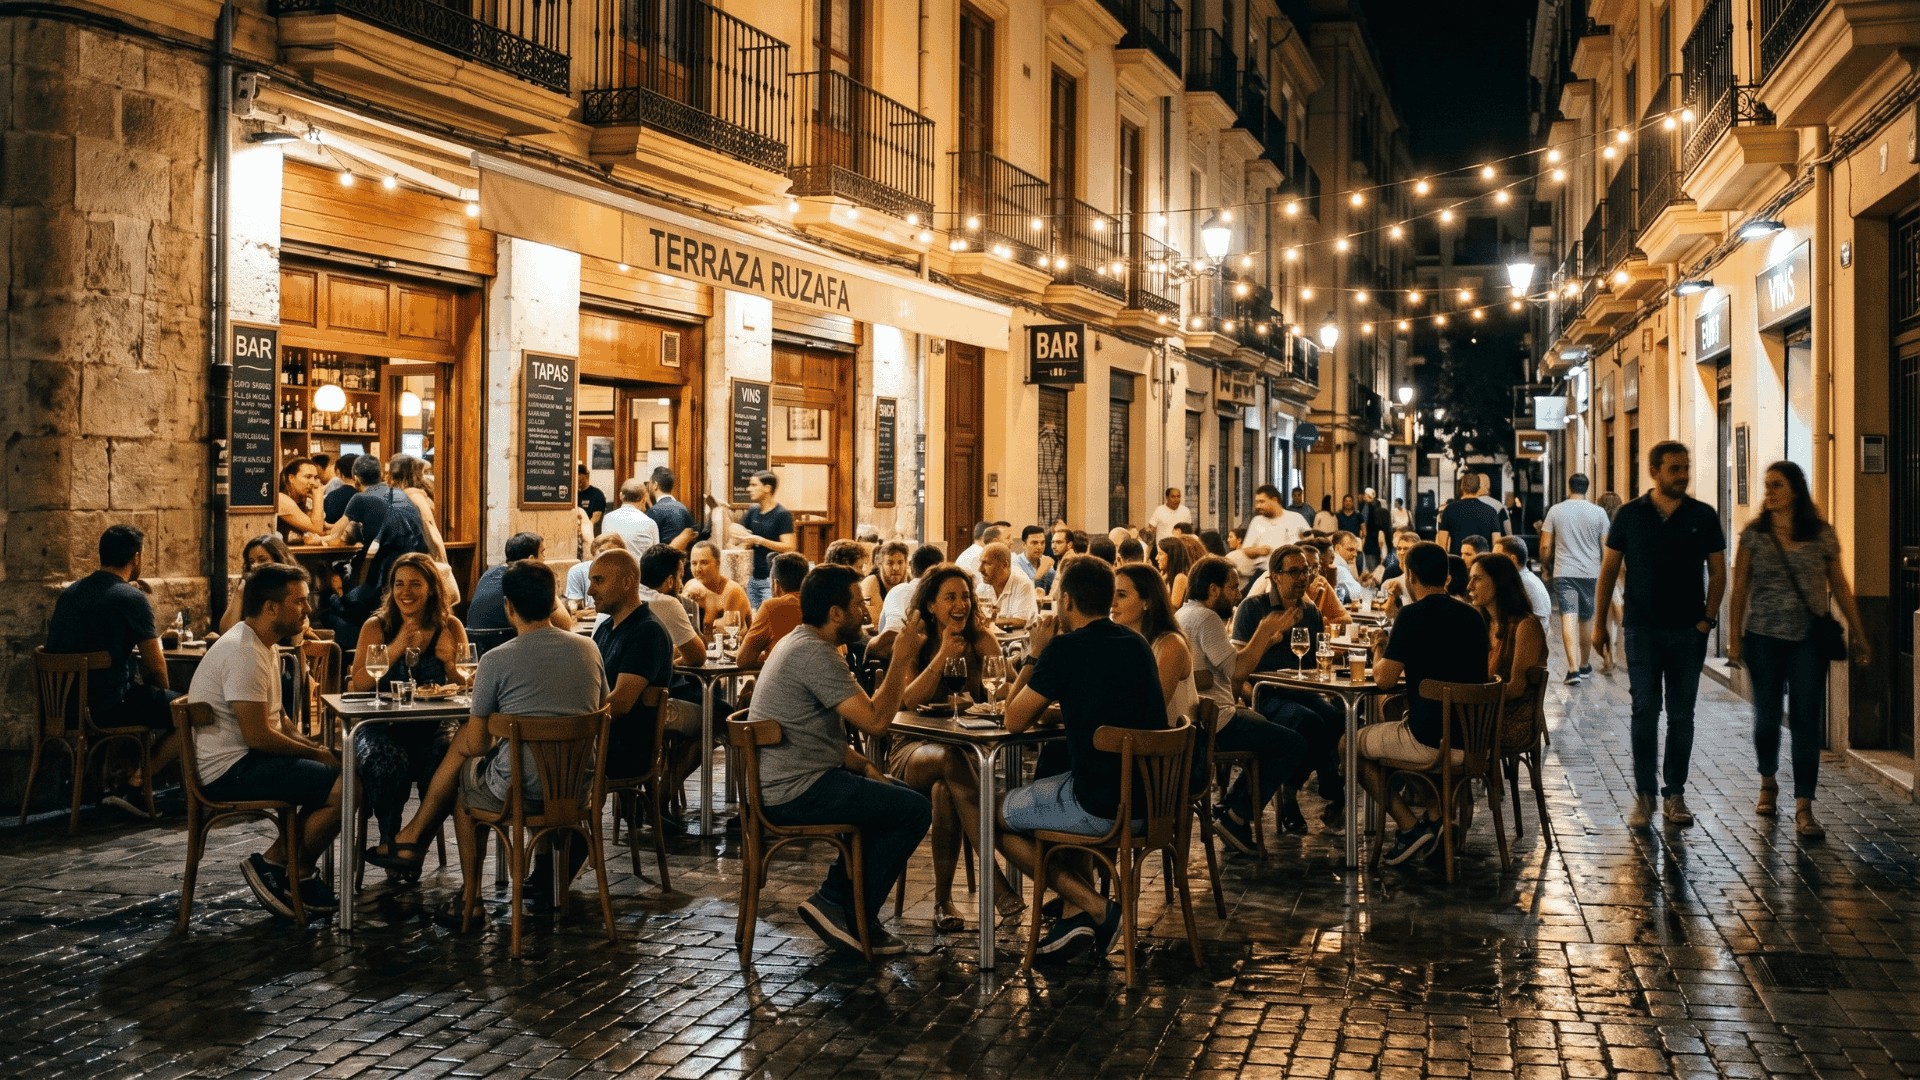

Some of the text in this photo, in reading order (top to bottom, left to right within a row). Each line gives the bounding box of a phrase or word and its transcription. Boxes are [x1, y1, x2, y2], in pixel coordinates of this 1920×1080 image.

[649, 227, 851, 312] TERRAZA RUZAFA
[1768, 264, 1795, 312] VINS
[235, 334, 272, 360] BAR
[1036, 331, 1078, 359] BAR
[532, 361, 569, 383] TAPAS
[741, 386, 761, 404] VINS
